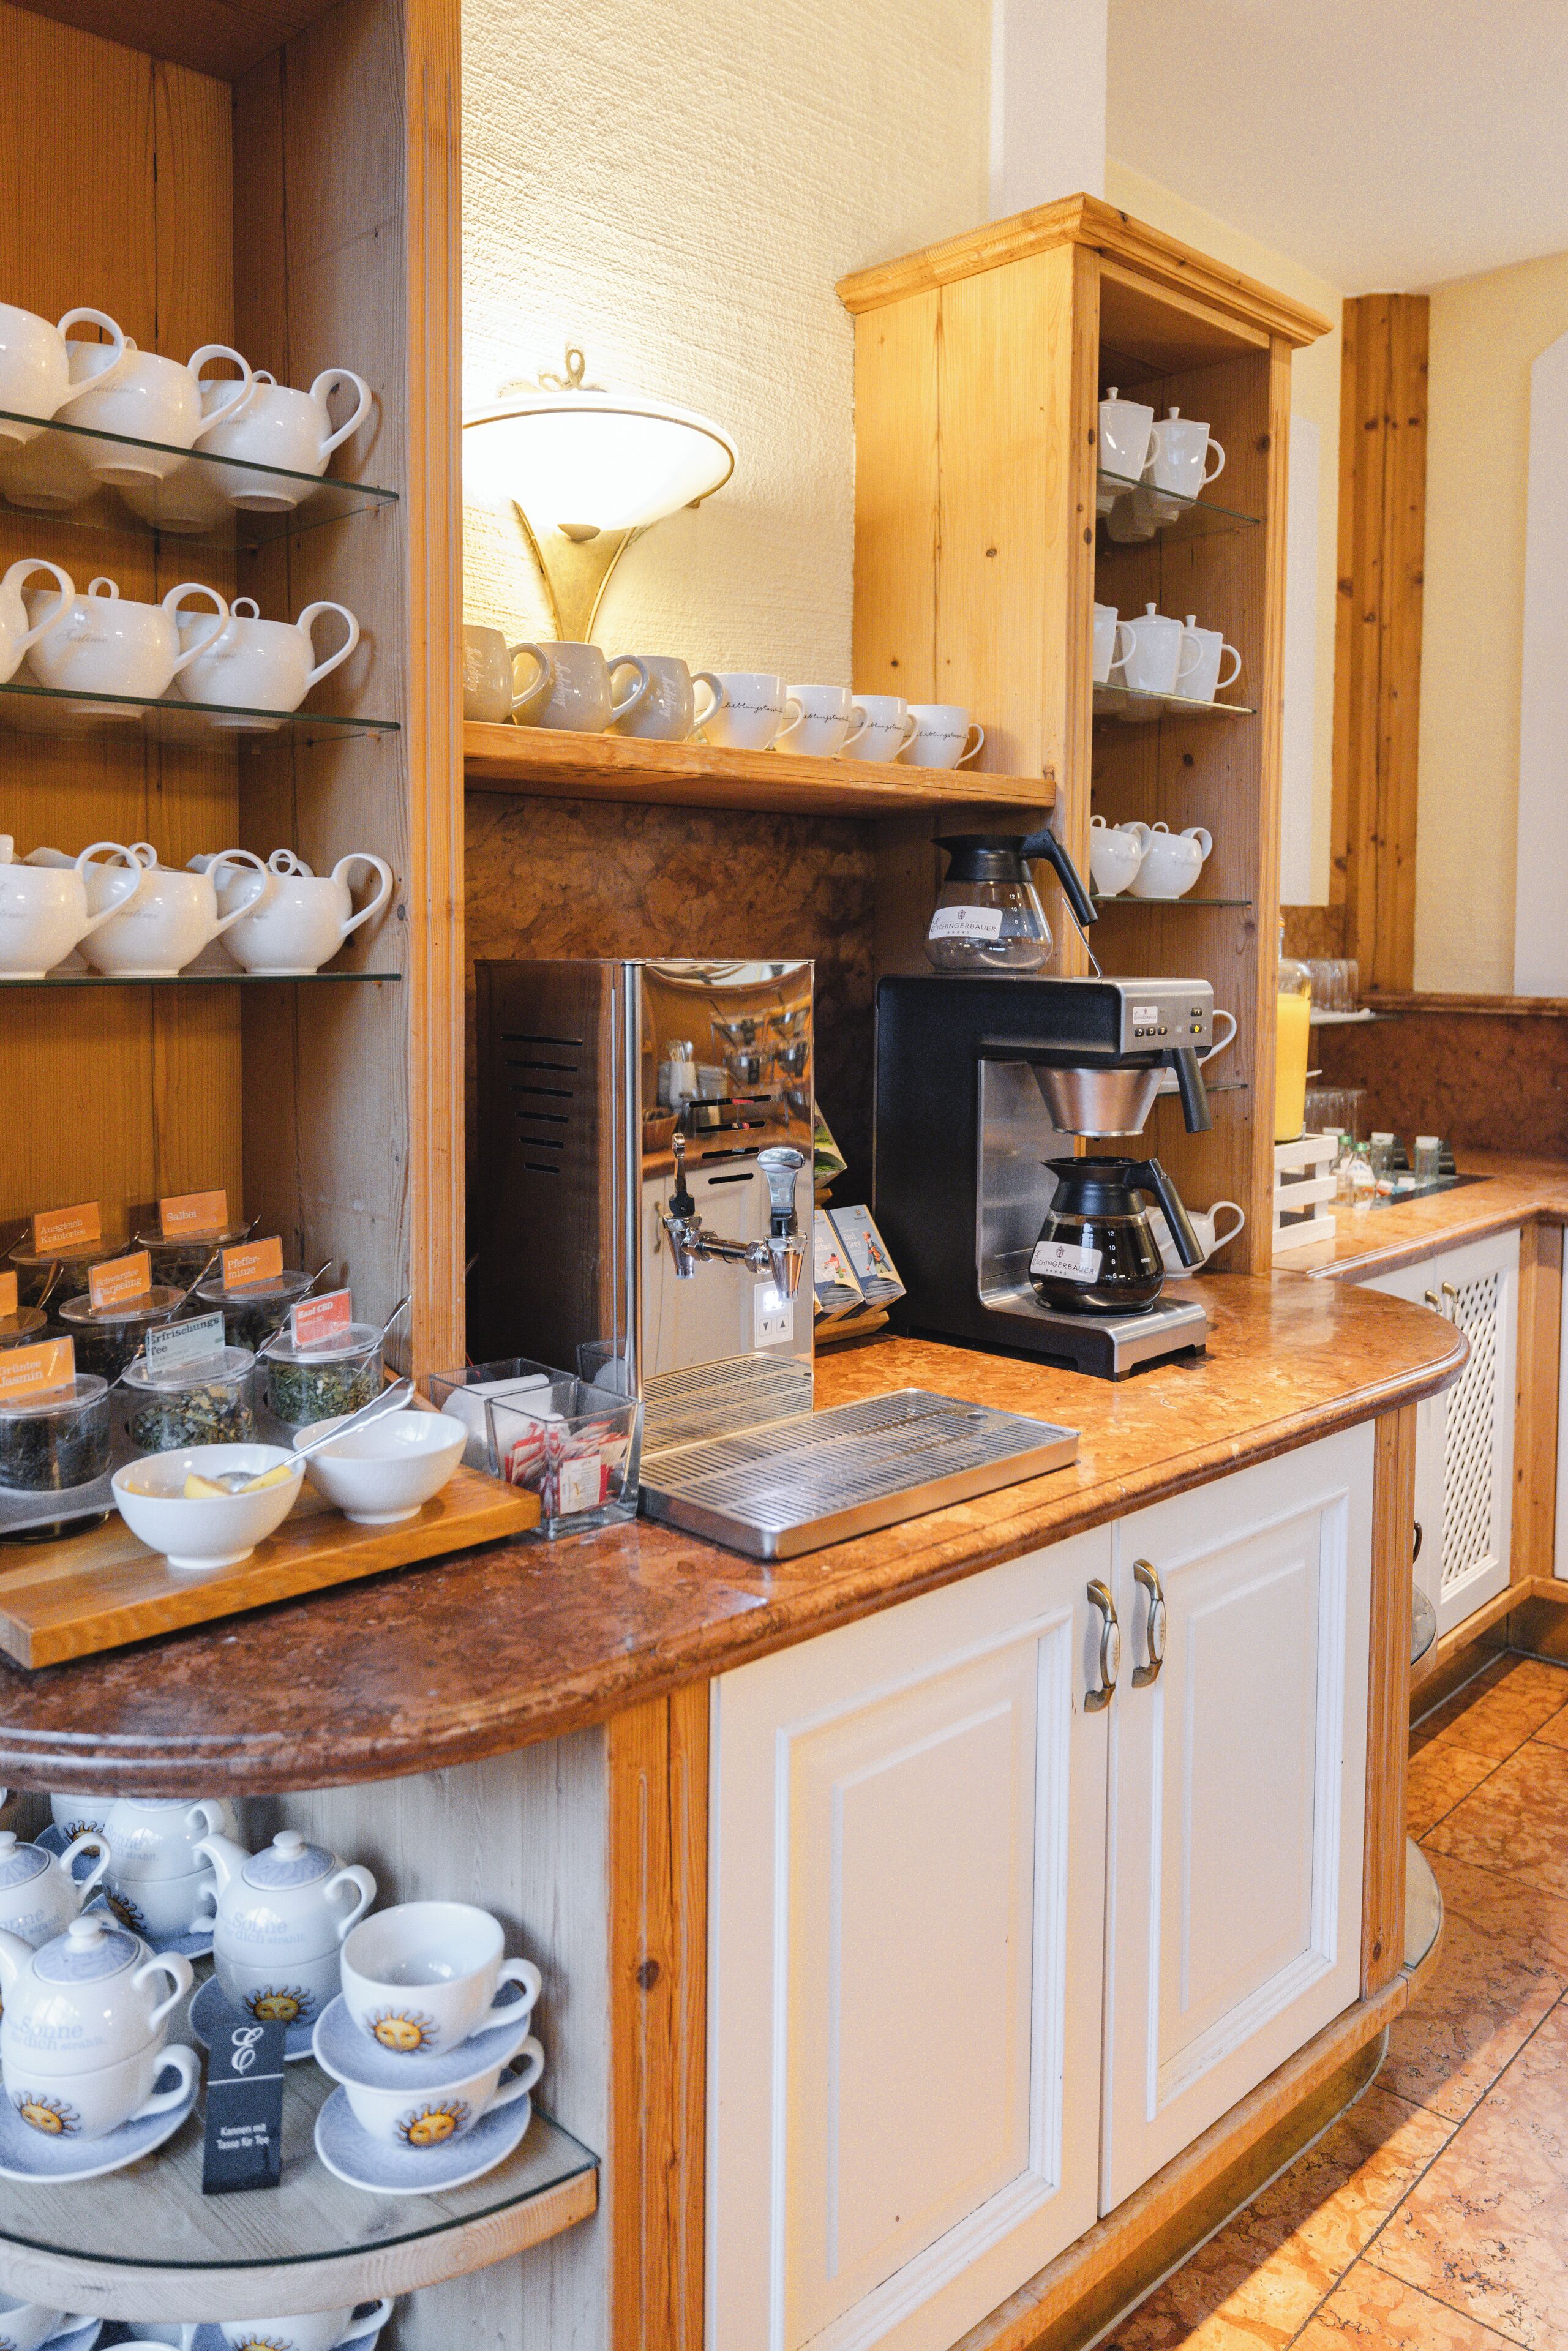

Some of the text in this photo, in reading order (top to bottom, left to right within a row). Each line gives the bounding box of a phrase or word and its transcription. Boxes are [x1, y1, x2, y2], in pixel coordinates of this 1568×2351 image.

[167, 1209, 197, 1222] Salbei
[40, 1218, 83, 1235] Ausgleich
[41, 1229, 86, 1244] Kräutertee
[227, 1255, 261, 1270] Pfeffer-
[96, 1269, 139, 1286] Schwarztee
[228, 1266, 256, 1280] minze
[147, 1317, 220, 1345] Erfrischungs
[0, 1370, 43, 1389] Jasmin
[20, 2015, 84, 2039] Sonne
[220, 2123, 267, 2137] Kannen mit
[216, 2135, 270, 2150] Tasse für Tee
